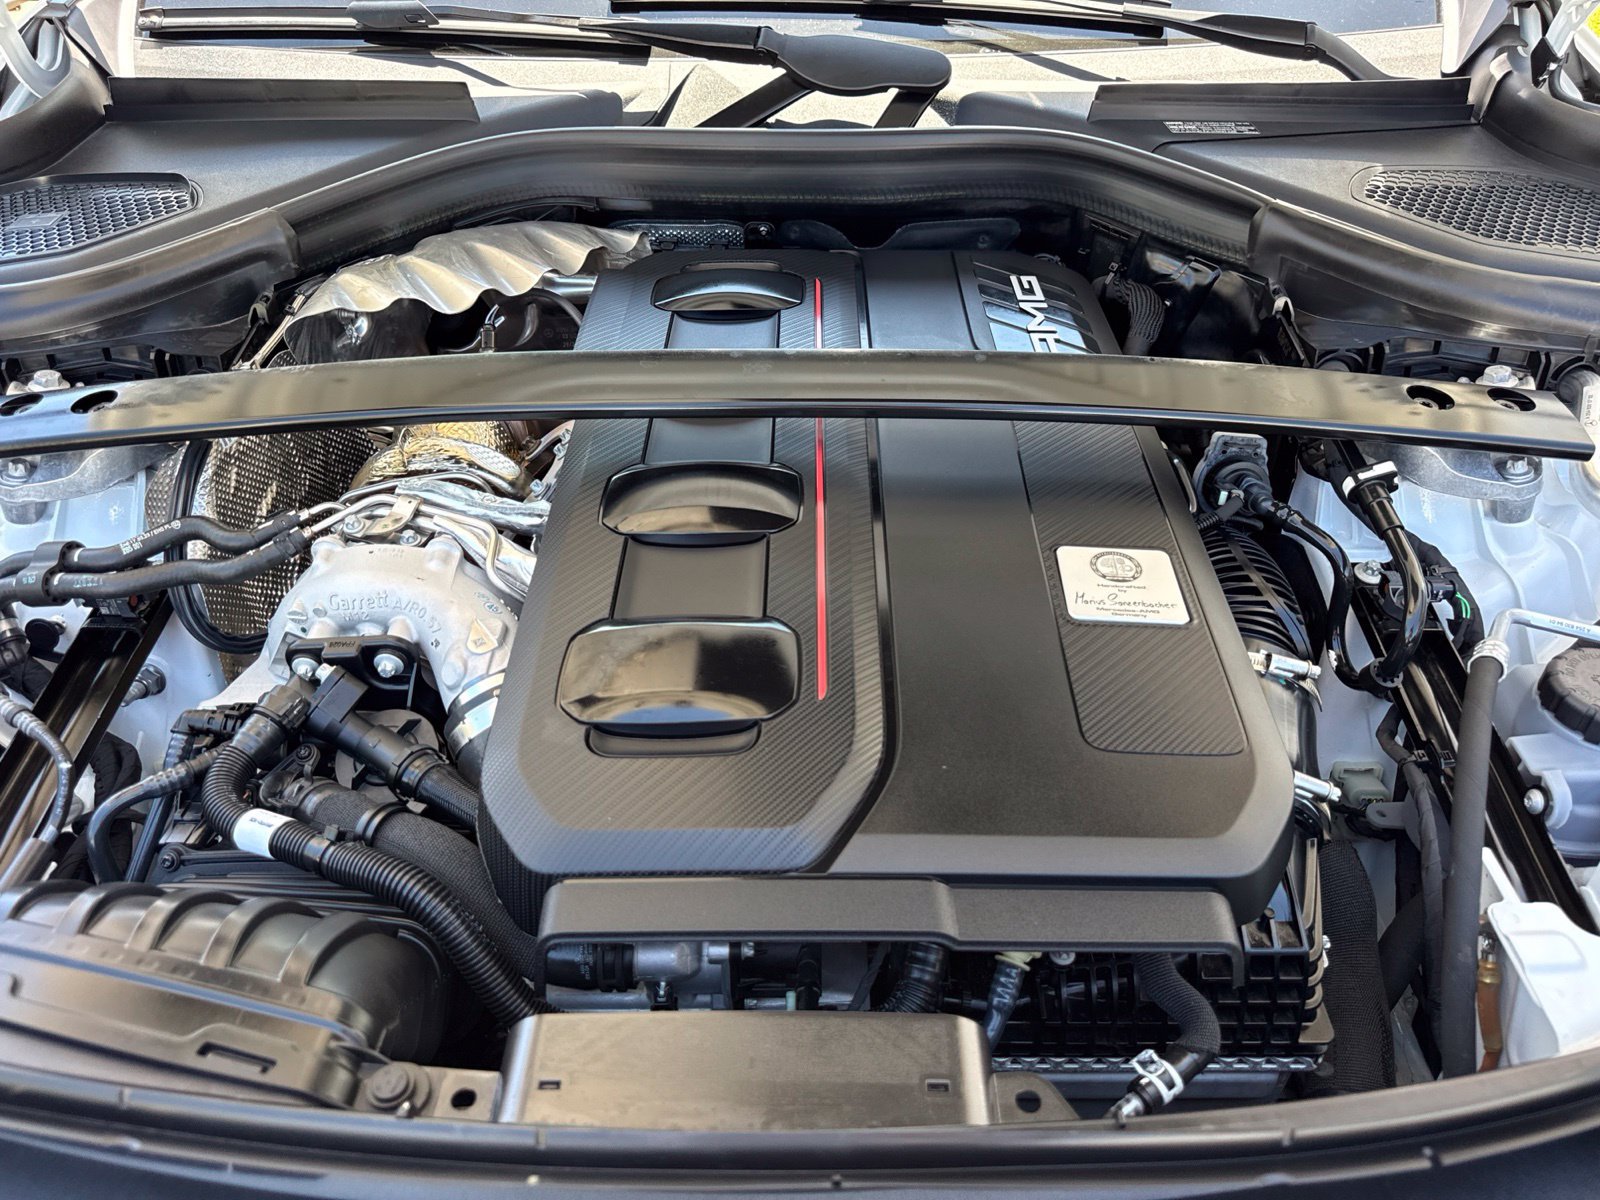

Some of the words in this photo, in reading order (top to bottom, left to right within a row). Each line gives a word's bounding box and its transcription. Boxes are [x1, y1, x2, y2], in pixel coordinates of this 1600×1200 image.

[1009, 275, 1058, 353] AMG
[329, 590, 389, 612] Garrett
[1096, 606, 1161, 615] Mercedes-AMG
